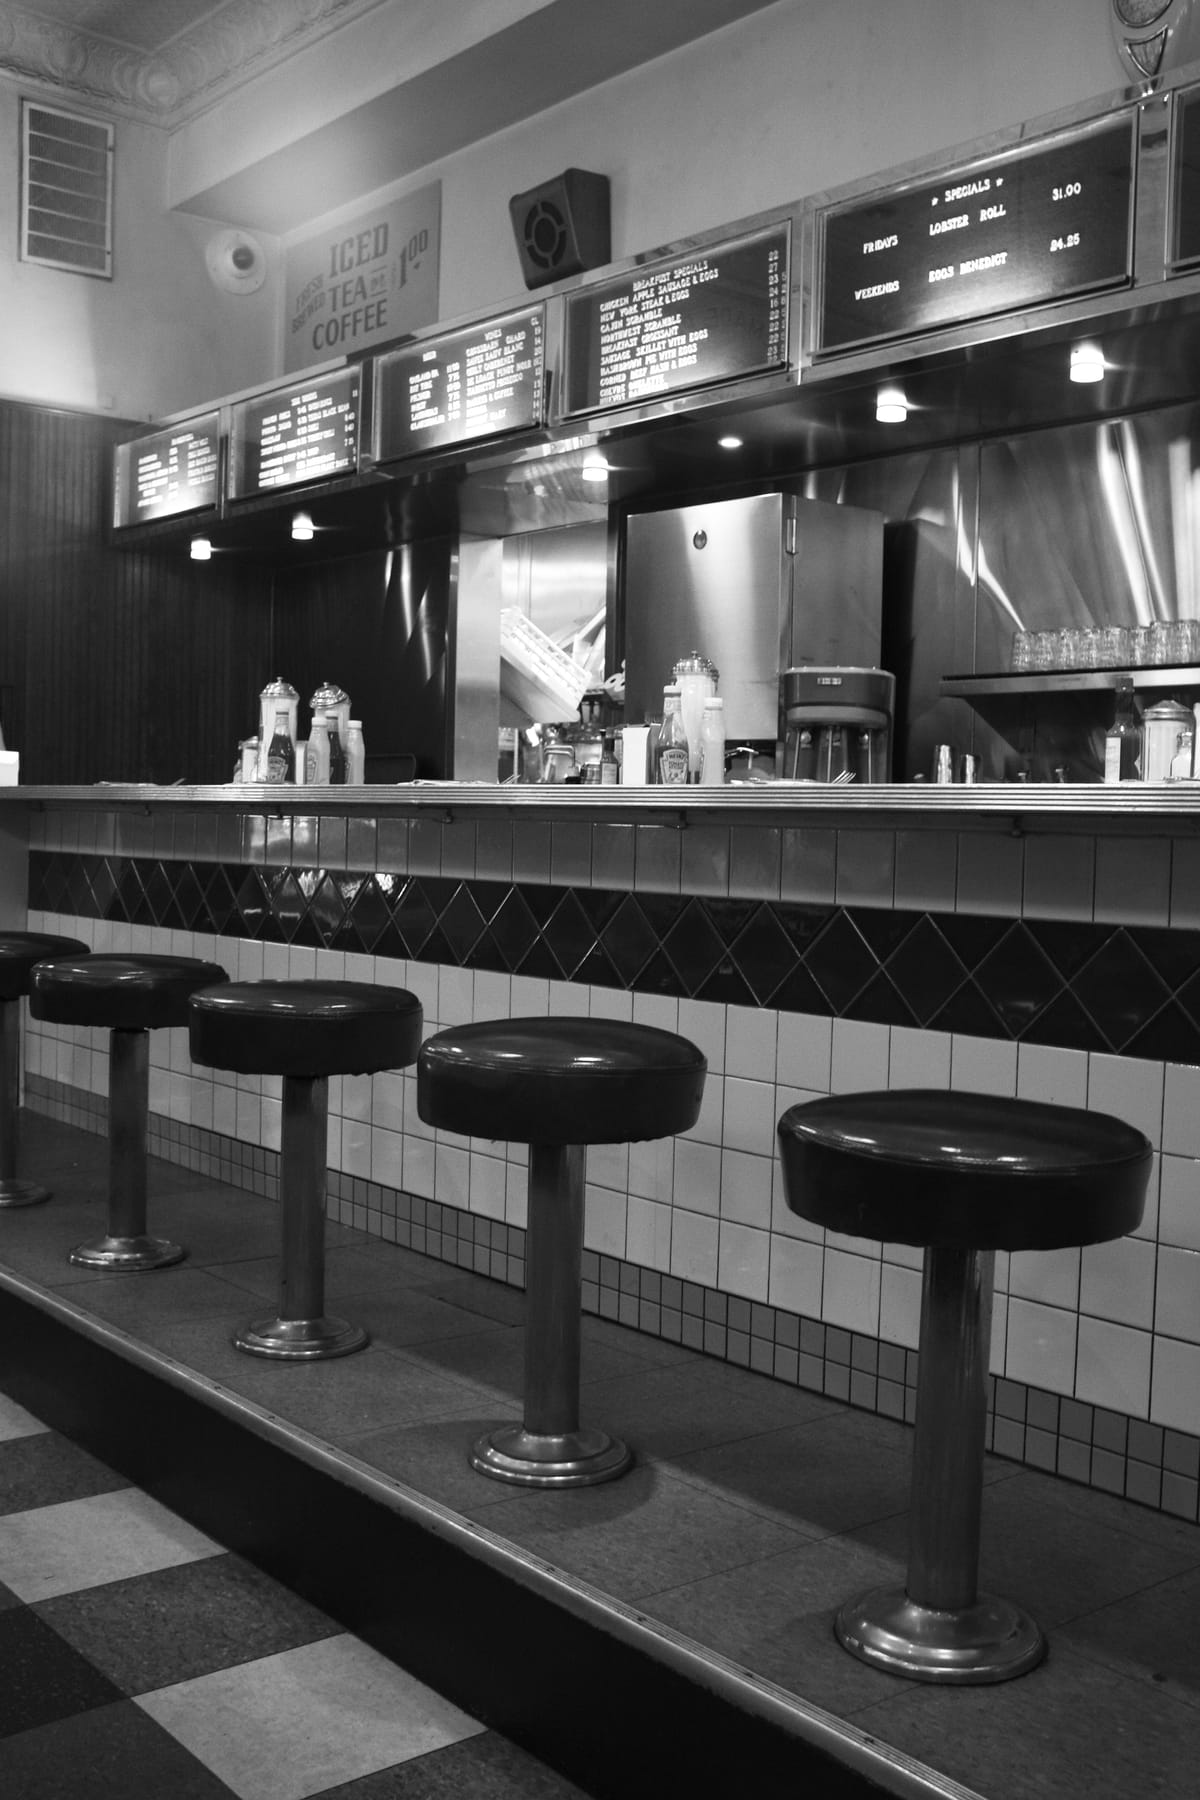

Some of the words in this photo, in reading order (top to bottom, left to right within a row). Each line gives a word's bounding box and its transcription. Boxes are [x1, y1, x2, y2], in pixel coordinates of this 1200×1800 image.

[945, 178, 990, 202] SPECIALS
[863, 235, 899, 254] FRIDAYS
[929, 214, 968, 236] LOBSTER
[980, 204, 1006, 222] ROLL
[1052, 182, 1082, 201] 31.00
[329, 222, 388, 279] ICED
[854, 280, 900, 301] WEEKENDS
[928, 266, 955, 283] EGGS
[959, 252, 1008, 276] BENEDICT
[1050, 233, 1080, 252] 24.25
[674, 261, 708, 278] SPECIALS
[328, 276, 367, 312] TEA
[600, 296, 629, 312] CHICKEN
[633, 289, 654, 302] APPLE
[658, 277, 690, 295] SAUSAGE
[700, 269, 718, 282] EGGS
[601, 311, 615, 323] NEW
[620, 304, 638, 317] YORK
[641, 296, 664, 311] STEAK
[671, 289, 689, 302] EGGS
[312, 299, 387, 350] COFFEE
[601, 320, 623, 333] CAJUN
[626, 308, 662, 326] SCRAMBLE
[601, 326, 641, 344] NORTHWEST
[644, 314, 681, 332] SCRAMBLE
[601, 351, 631, 365] SAUSAGE
[636, 341, 666, 356] SKILLET
[668, 335, 686, 347] WITH
[689, 329, 708, 342] EGGS
[602, 338, 637, 355] BREAKFAST
[642, 326, 679, 344] CROISSANT
[600, 373, 626, 386] CORNED
[650, 362, 669, 374] HASH
[678, 355, 697, 368] EGGS
[601, 358, 642, 376] HASHBROWN
[659, 348, 677, 360] WITH
[678, 343, 697, 357] EGGS
